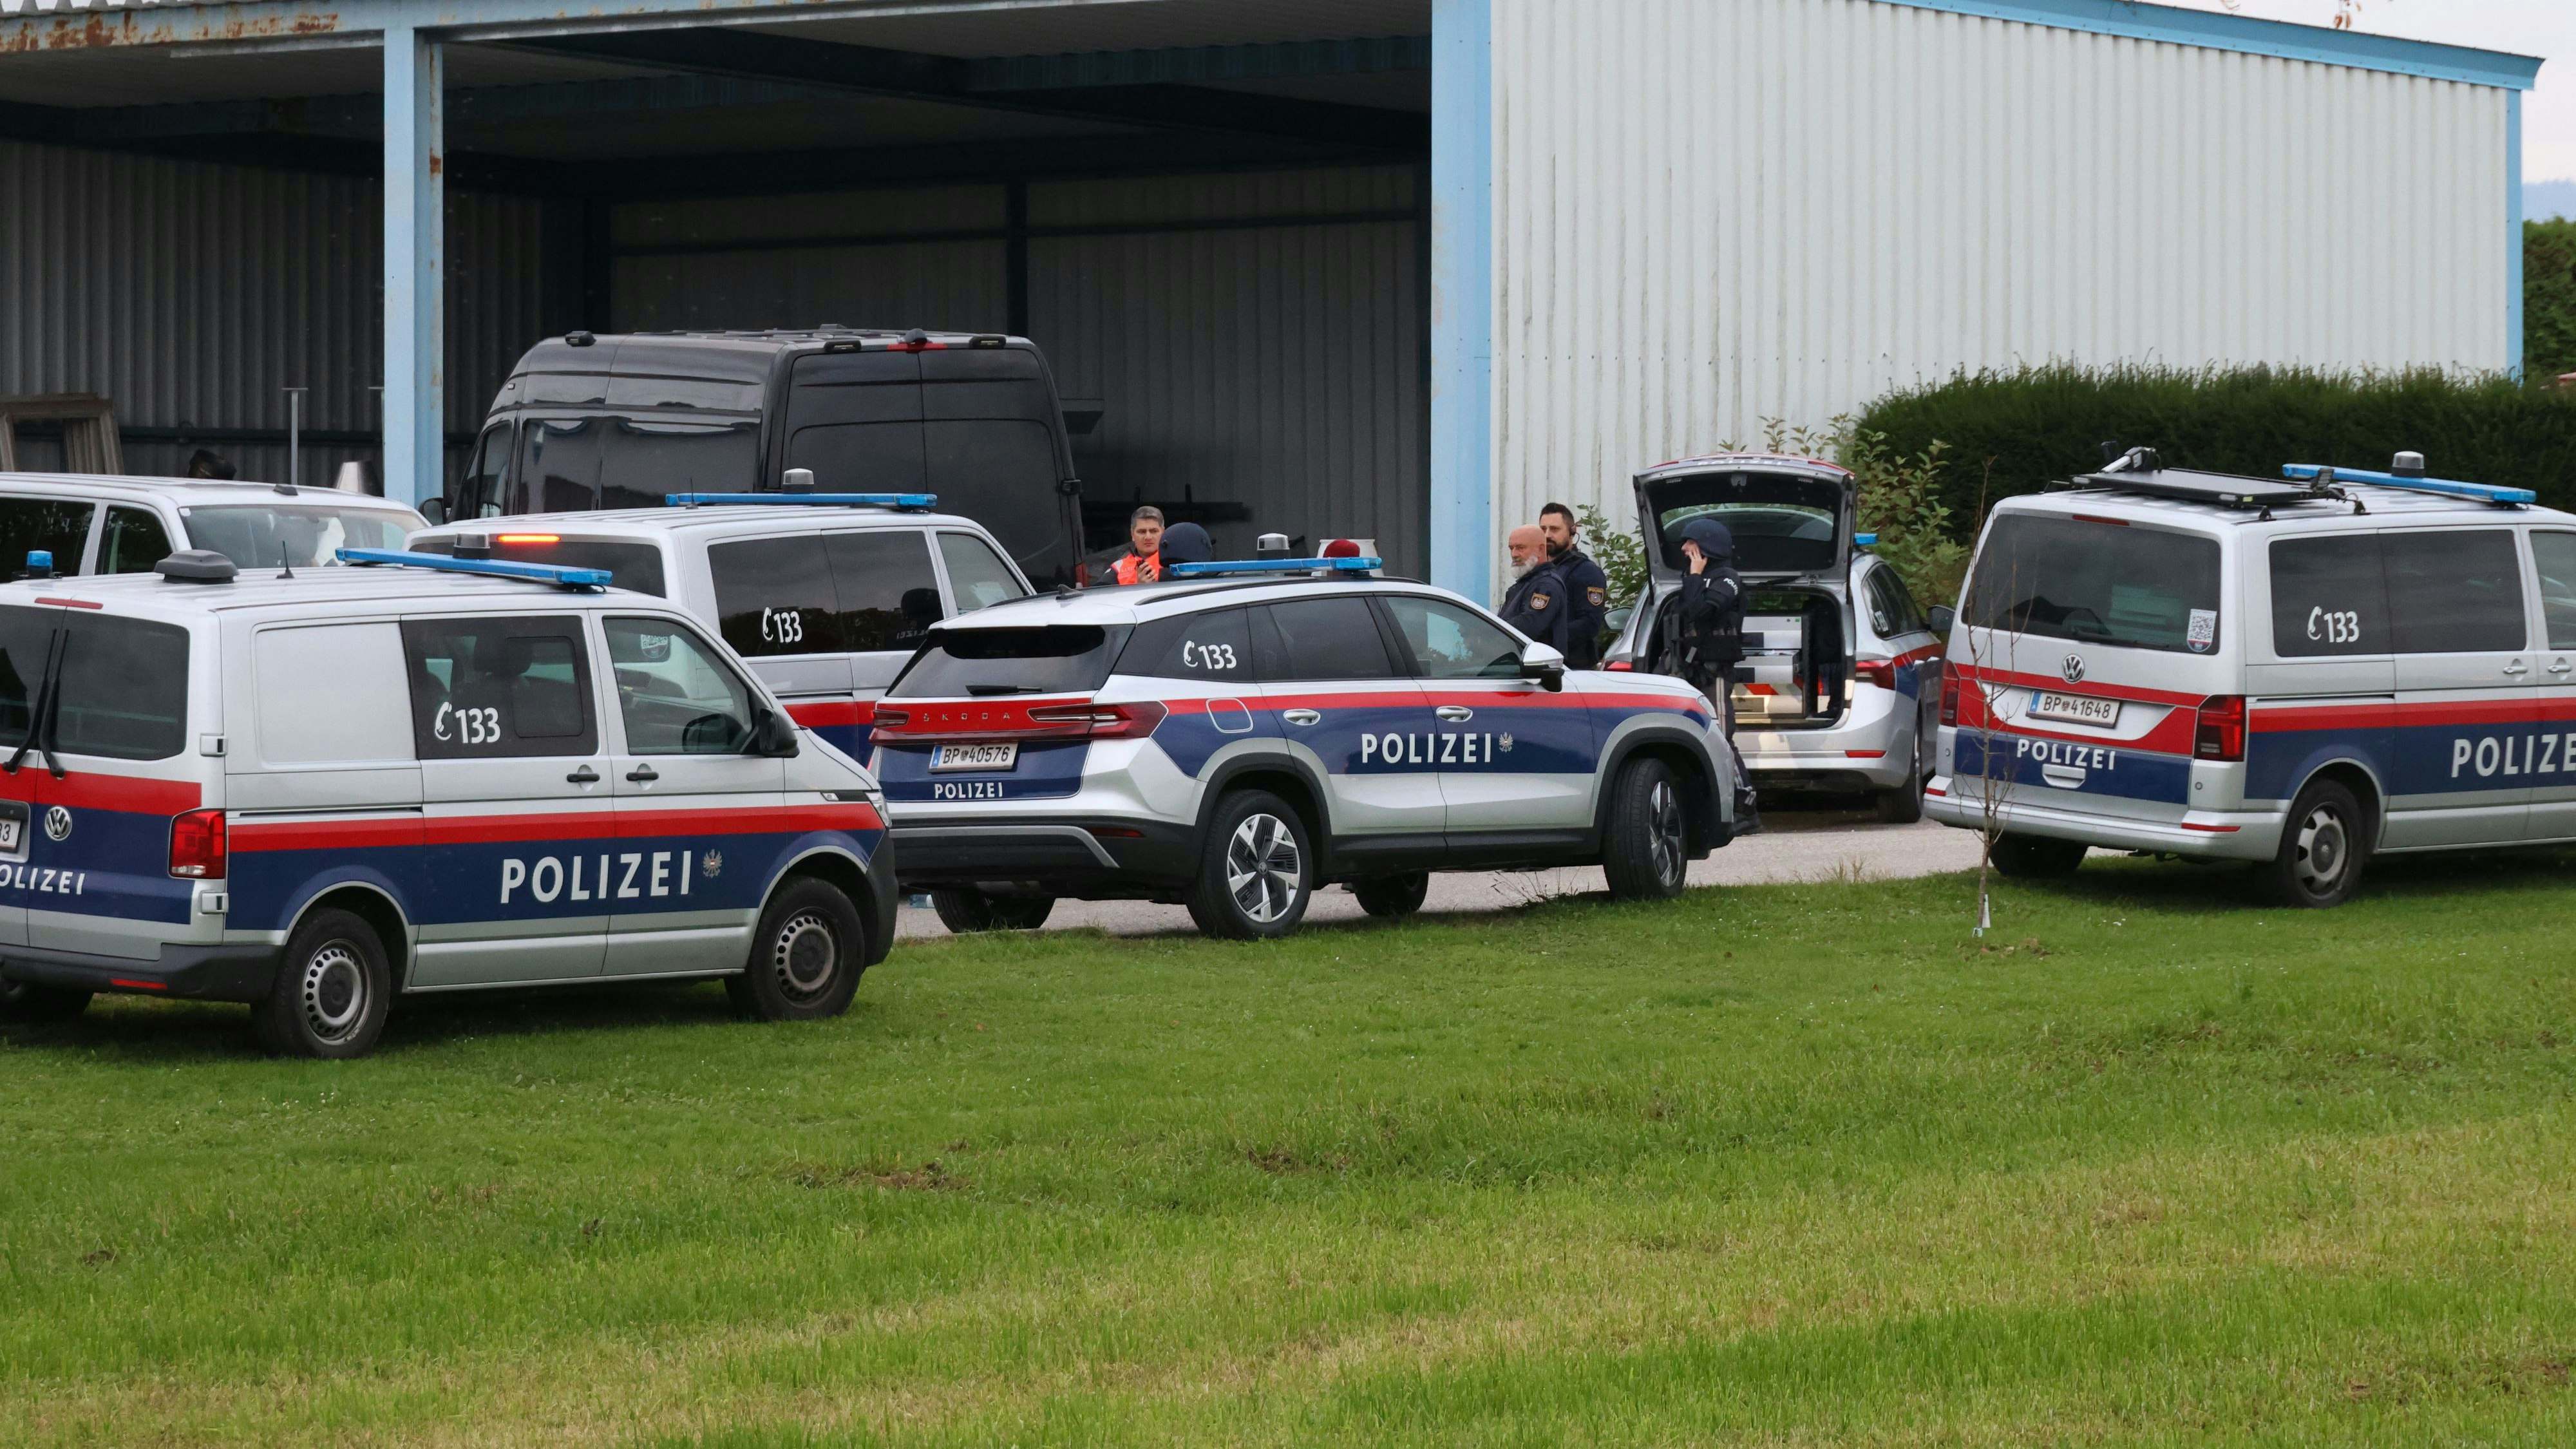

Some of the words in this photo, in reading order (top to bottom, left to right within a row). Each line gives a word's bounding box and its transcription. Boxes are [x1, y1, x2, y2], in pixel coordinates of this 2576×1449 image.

[773, 611, 802, 643] 133
[2324, 611, 2360, 643] 133
[1198, 644, 1236, 669] 133
[2043, 696, 2061, 712] BP
[2071, 699, 2110, 718] 41648
[455, 707, 500, 743] 133
[943, 748, 960, 764] BP
[969, 746, 1010, 762] 40576
[1361, 733, 1492, 764] POLIZEI
[2017, 739, 2116, 770] POLIZEI
[2451, 733, 2576, 778] POLIZE
[934, 782, 1003, 799] POLIZEI
[500, 850, 692, 904] POLIZEI
